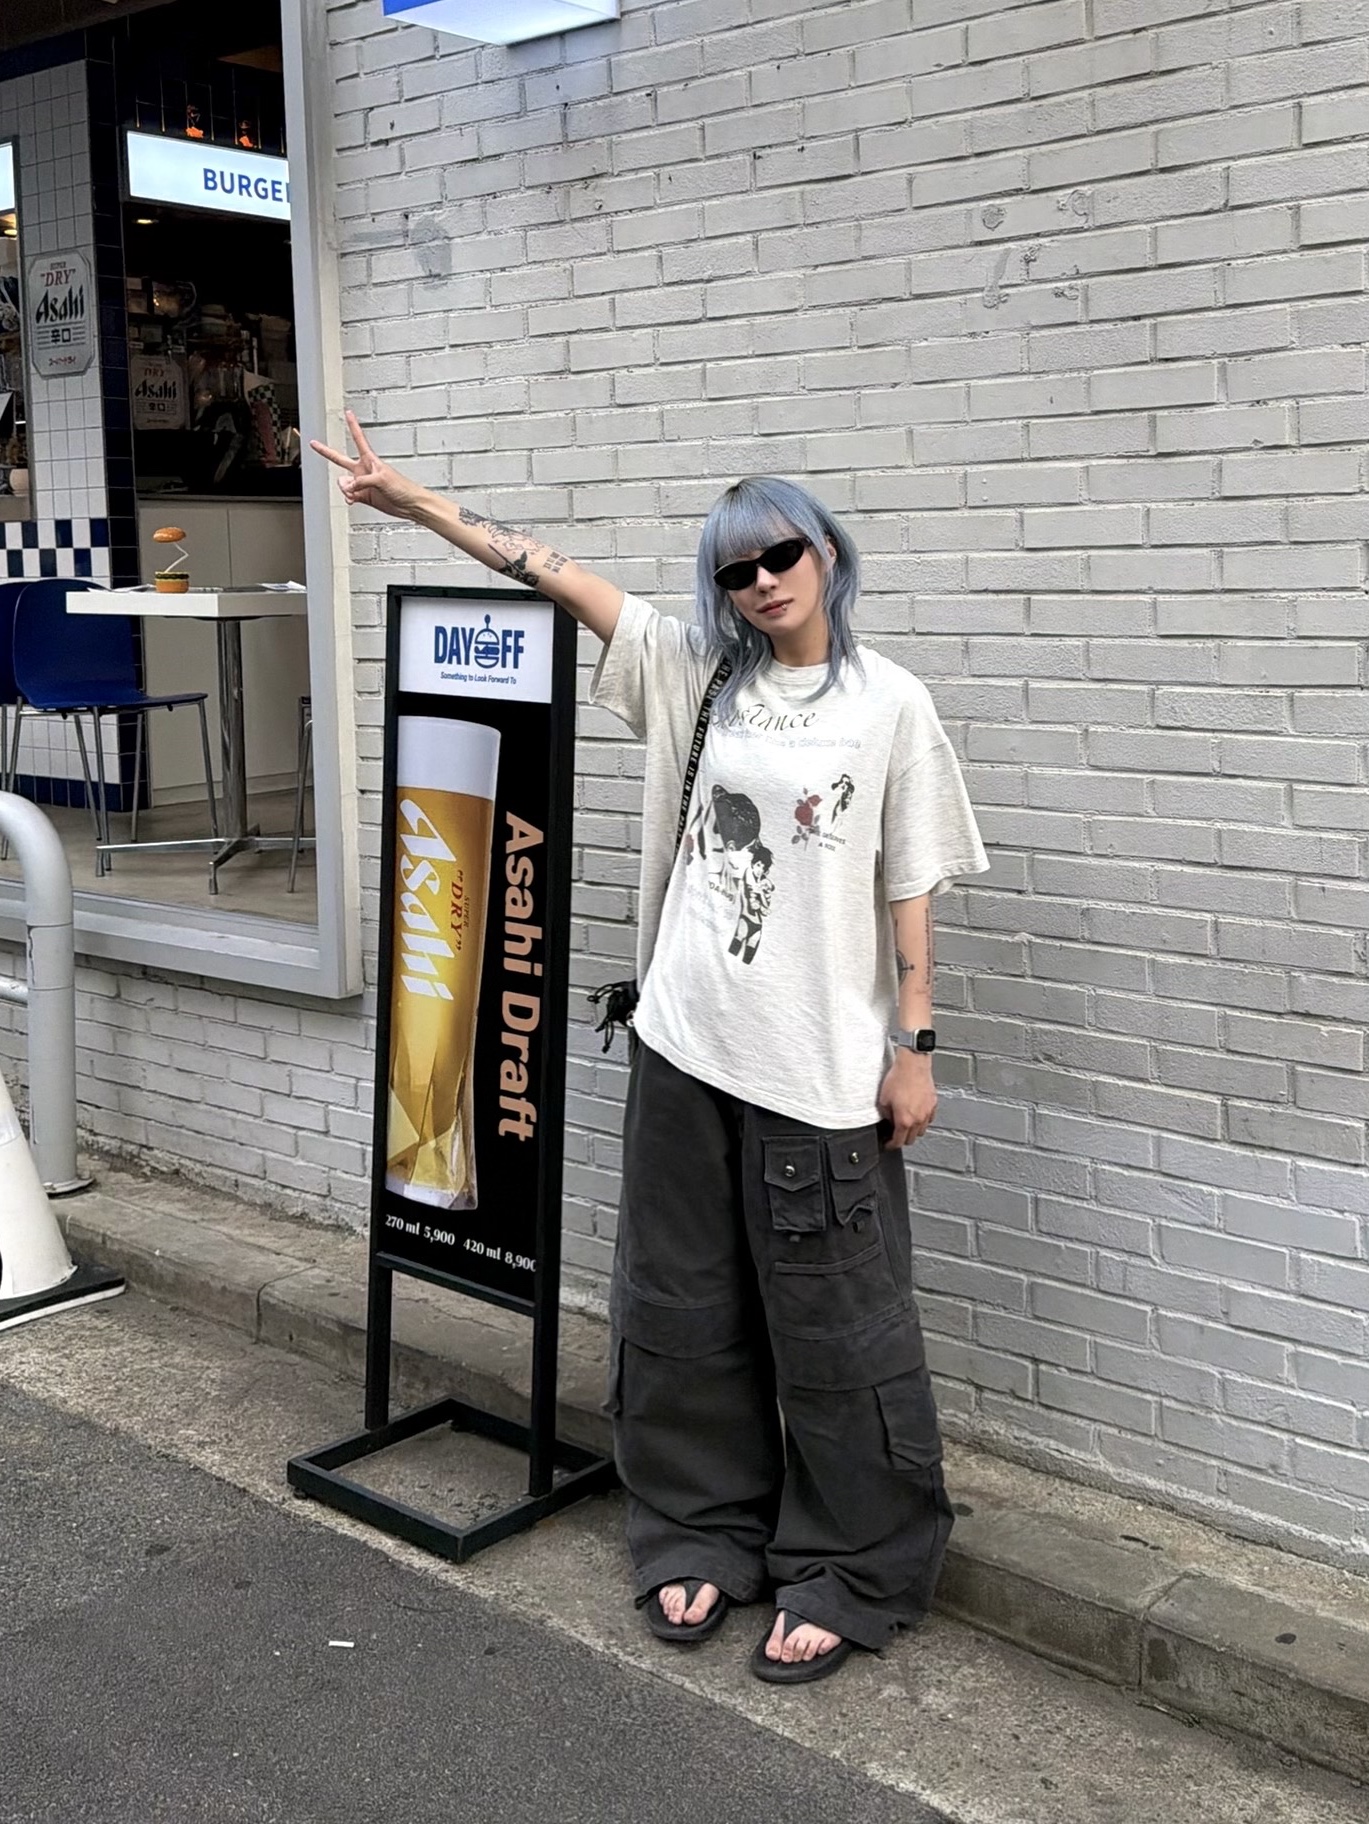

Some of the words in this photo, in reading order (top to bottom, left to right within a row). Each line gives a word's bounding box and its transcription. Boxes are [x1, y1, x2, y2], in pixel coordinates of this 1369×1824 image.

[203, 167, 290, 203] BURGE
[36, 284, 84, 323] Asahi
[134, 379, 177, 399] Asahi
[440, 671, 467, 682] Something
[474, 674, 487, 682] Look
[488, 675, 509, 684] Forward
[690, 726, 705, 764] FUTURE
[400, 799, 457, 1001] Asahi
[504, 811, 544, 976] Asahi
[499, 990, 541, 1141] Draft
[385, 1213, 404, 1230] 270
[405, 1222, 420, 1235] ml
[423, 1226, 456, 1246] 5,900
[463, 1238, 484, 1255] 420
[486, 1247, 501, 1260] ml
